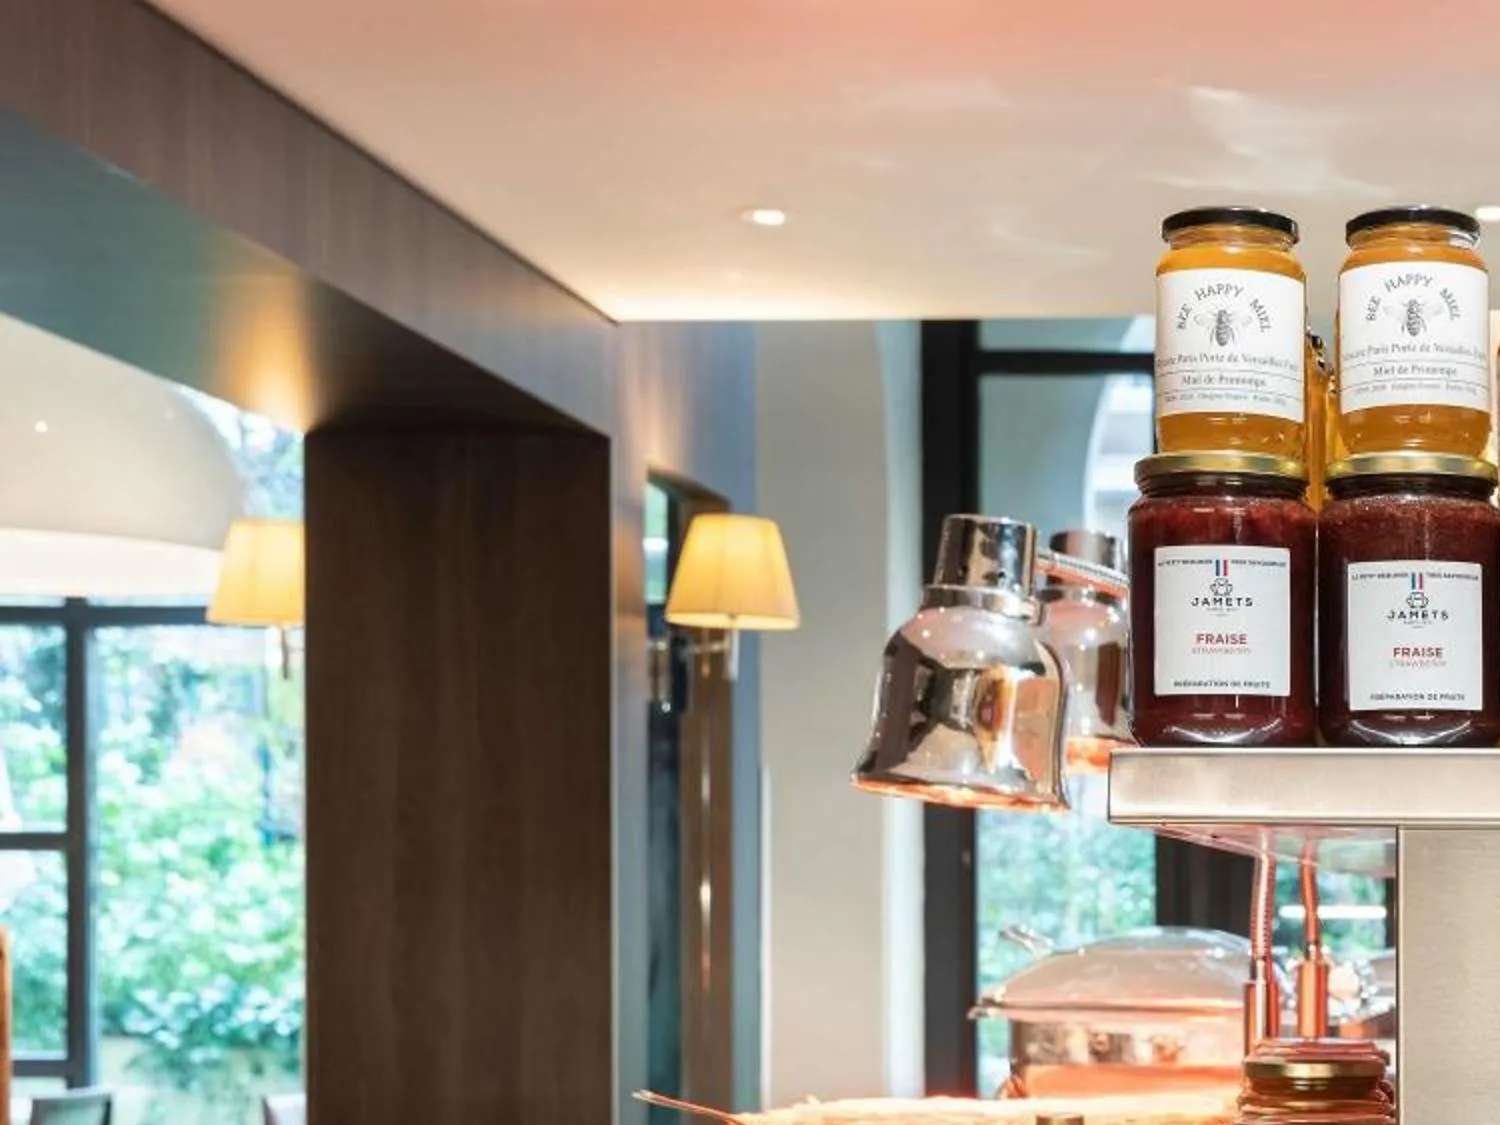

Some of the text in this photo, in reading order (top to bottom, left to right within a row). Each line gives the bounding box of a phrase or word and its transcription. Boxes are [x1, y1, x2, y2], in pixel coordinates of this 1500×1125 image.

[1365, 272, 1462, 321] BEE HAPPY MIEL
[1176, 283, 1272, 333] BEE HAPPY MIEL
[1191, 597, 1253, 607] JAMETS
[1387, 610, 1449, 621] JAMETS
[1196, 633, 1247, 645] FRAISE
[1393, 647, 1444, 658] FRAISE
